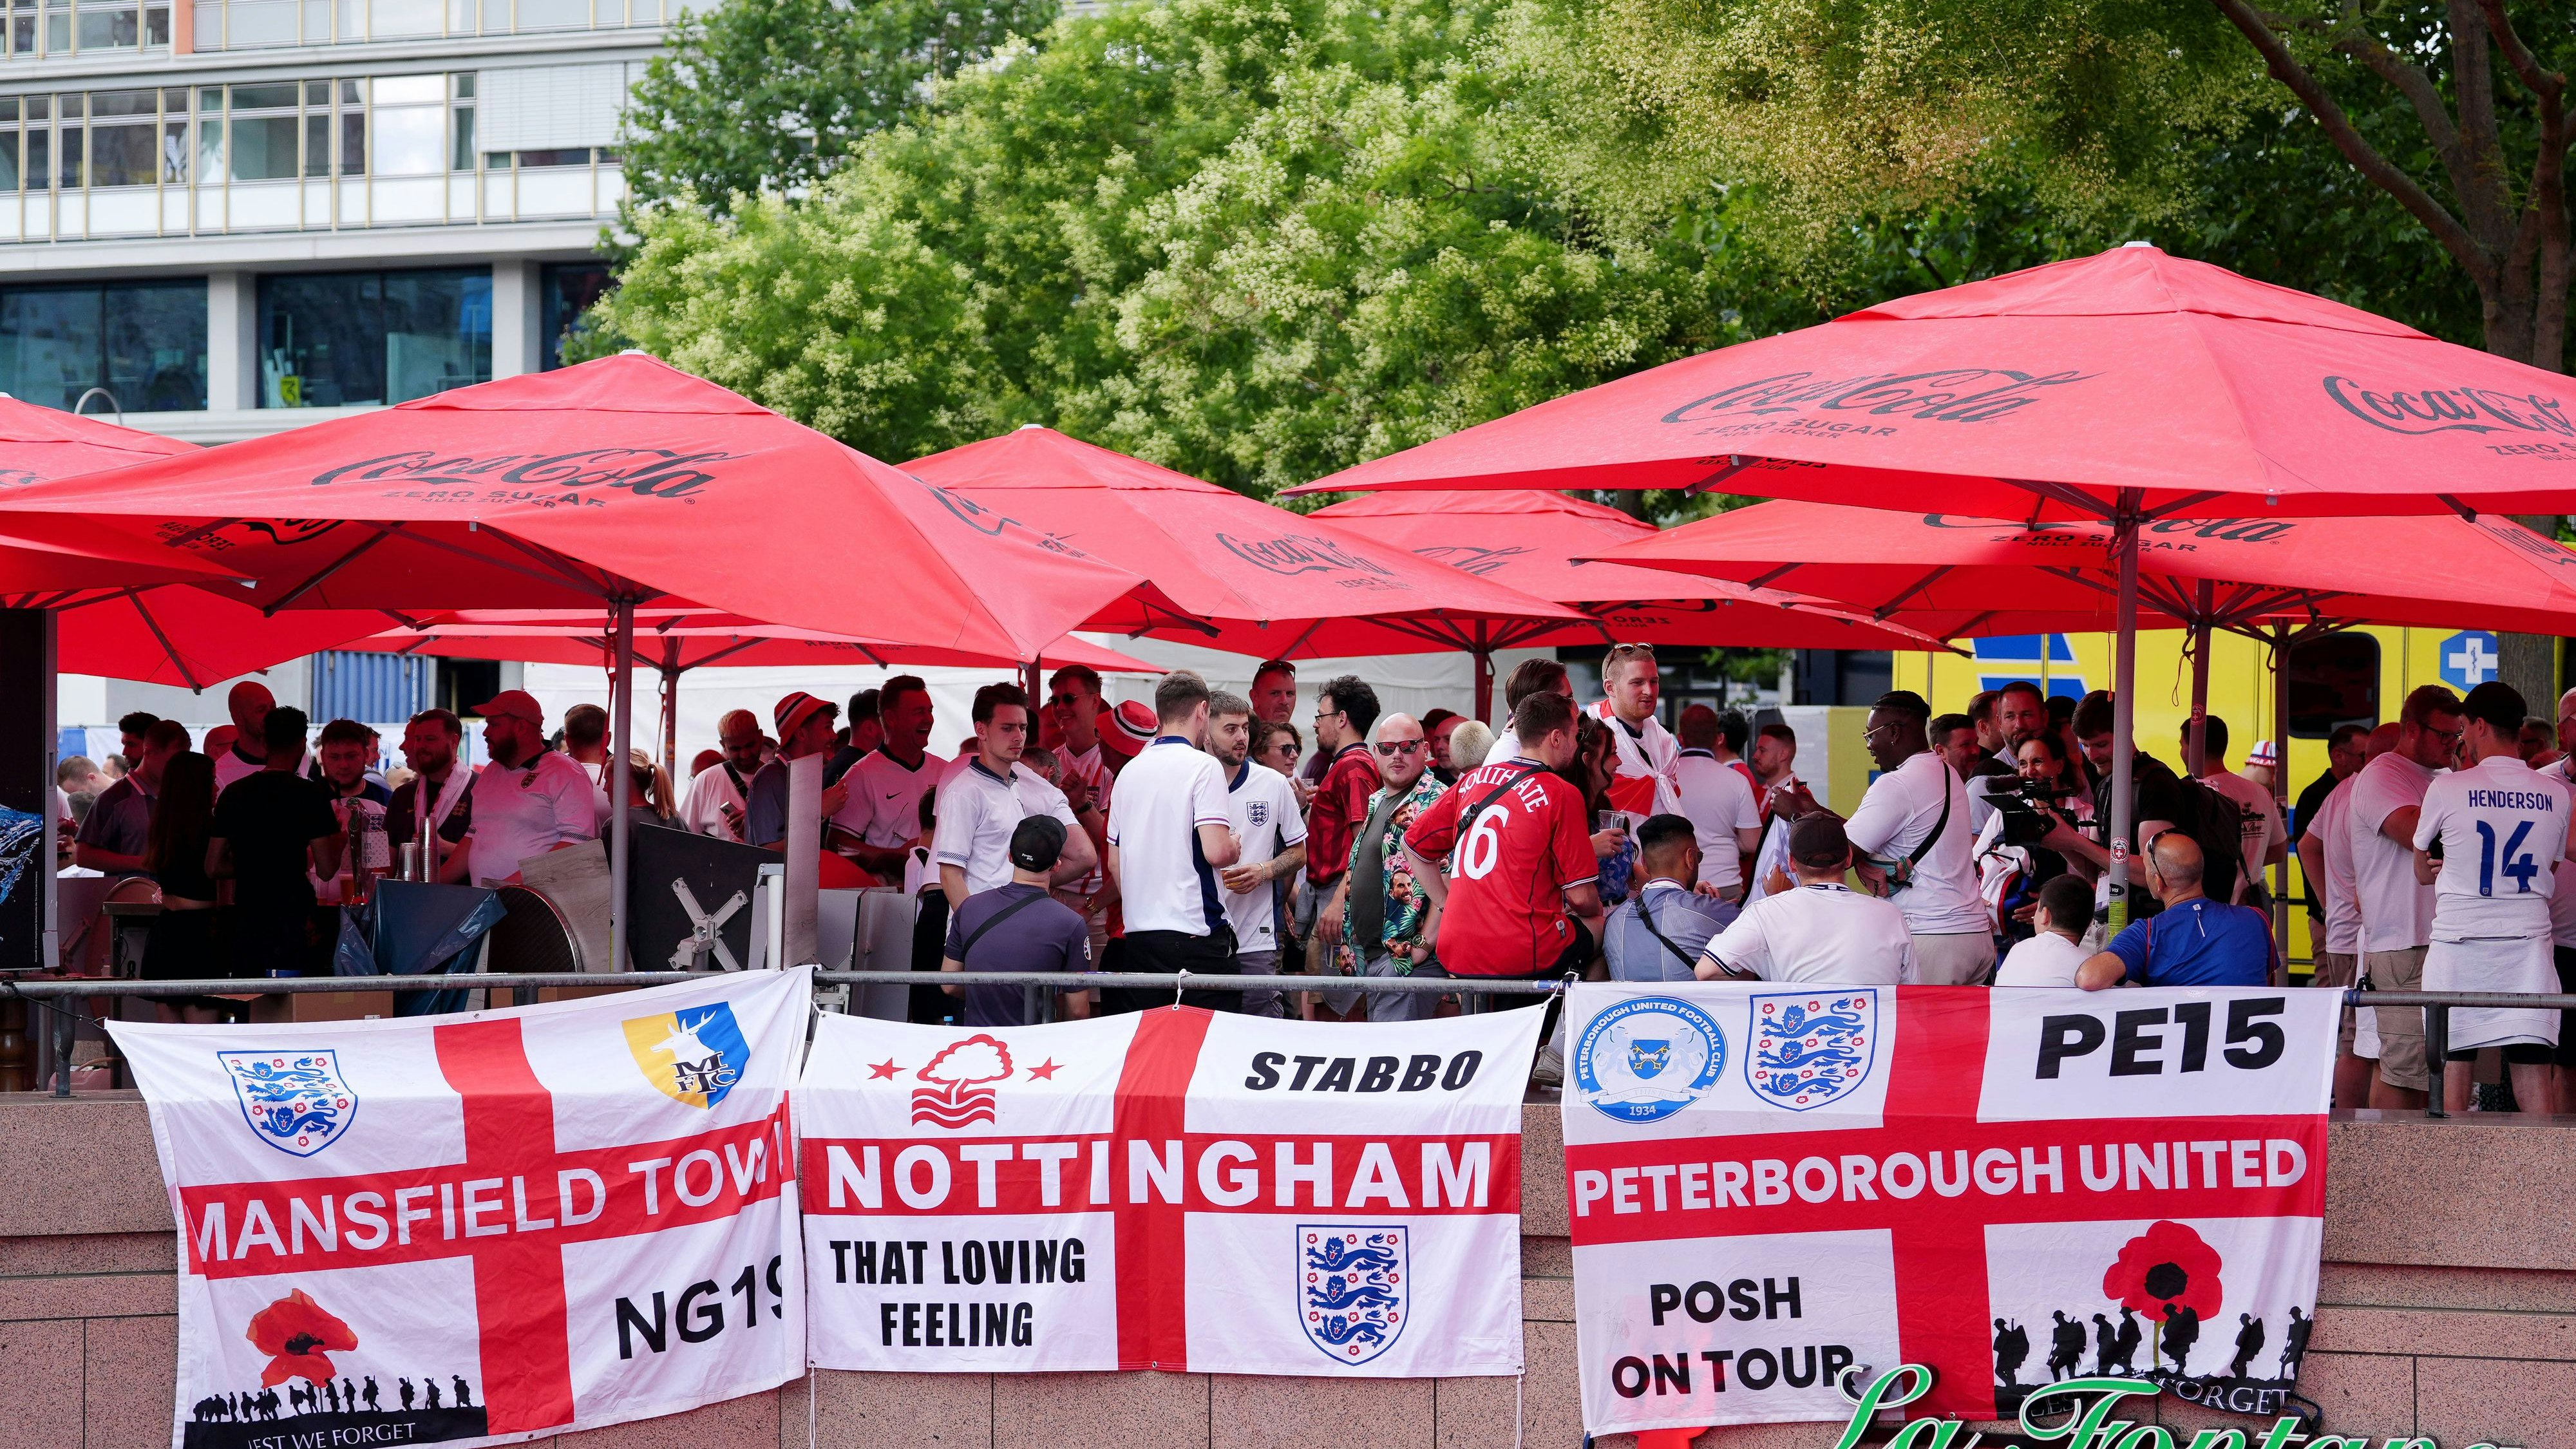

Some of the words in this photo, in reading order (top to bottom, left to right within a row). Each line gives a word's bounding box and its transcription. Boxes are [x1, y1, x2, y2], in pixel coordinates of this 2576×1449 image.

[1660, 369, 2108, 424] Coca-Cola
[1693, 421, 1778, 436] ZERO
[1784, 419, 1898, 437] SUGAR
[2485, 444, 2560, 455] ZERO
[312, 448, 734, 498] Coca-Cola
[1458, 766, 1549, 813] SOUTHATE
[2468, 790, 2553, 813] HENDERSON
[1450, 801, 1510, 880] 16
[2476, 820, 2539, 897] 14
[1580, 1006, 1631, 1081] PETERBOROUGH
[1632, 1001, 1678, 1011] UNITED
[1678, 1007, 1721, 1051] FOOTBALL
[1705, 1052, 1721, 1077] CLUB
[2035, 997, 2287, 1081] PE15
[1244, 1049, 1484, 1094] STABBO
[1629, 1105, 1656, 1116] 1934
[186, 1167, 607, 1262] MANSFIELD
[628, 1121, 783, 1216] TOW
[828, 1139, 1492, 1210] NOTTINGHAM
[1575, 1143, 2064, 1217] PETERBOROUGH
[2079, 1136, 2307, 1194] UNITED
[830, 1240, 929, 1285] THAT
[943, 1237, 1086, 1285] LOVING
[880, 1301, 1034, 1347] FEELING
[1651, 1276, 1803, 1327] POSH
[1612, 1354, 1692, 1400] ON
[1703, 1344, 1856, 1392] TOUR
[292, 1431, 327, 1449] WE
[332, 1422, 416, 1446] FORGET
